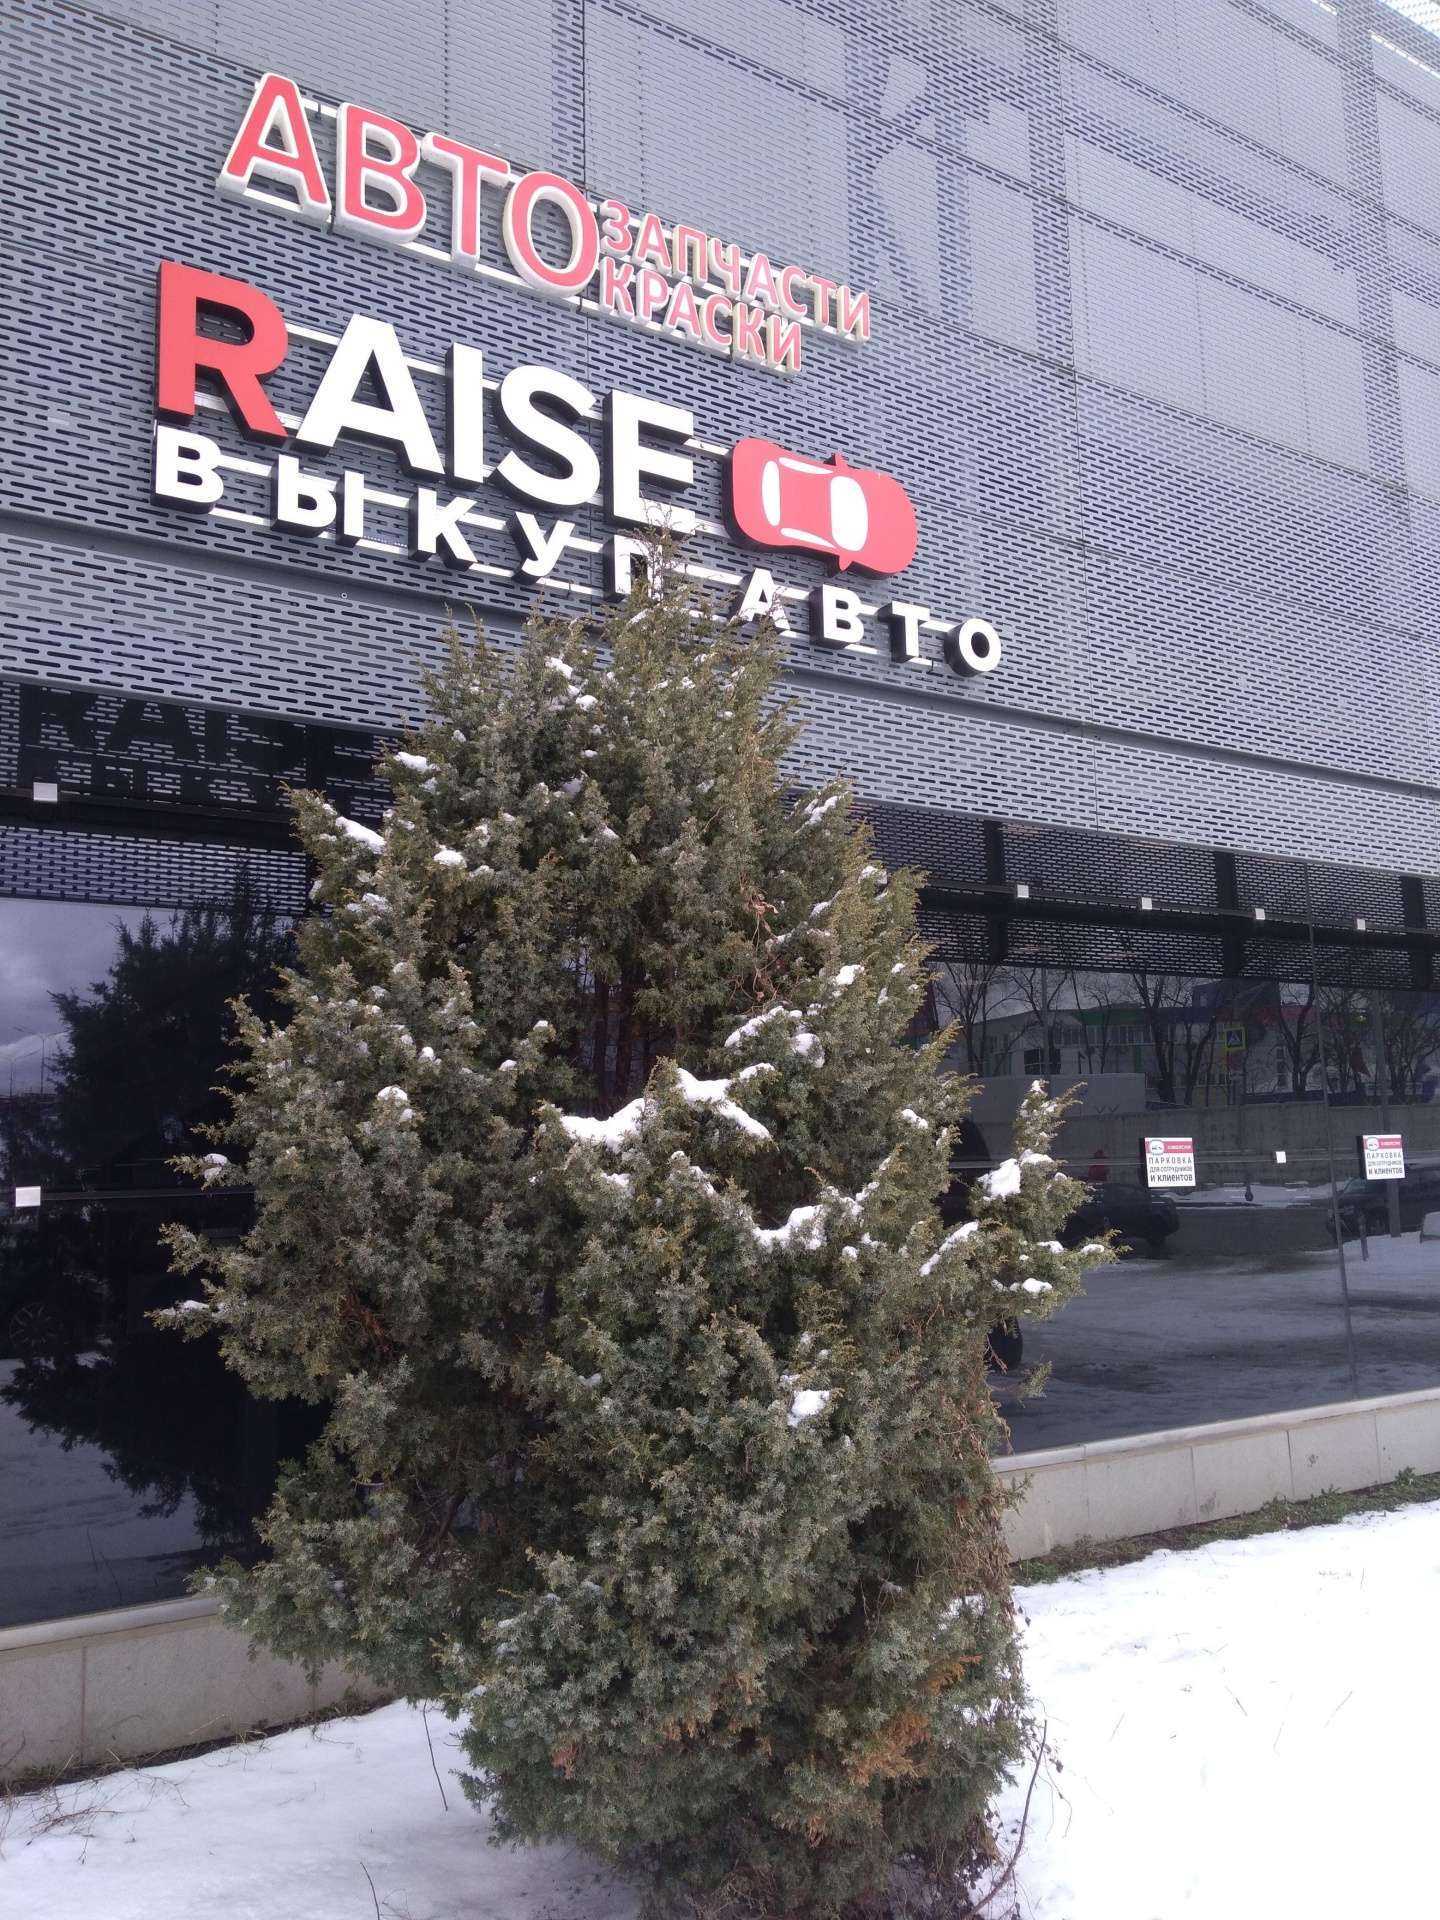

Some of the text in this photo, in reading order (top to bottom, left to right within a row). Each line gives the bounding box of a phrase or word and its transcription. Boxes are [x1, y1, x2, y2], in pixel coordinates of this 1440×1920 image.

[216, 71, 600, 299] АВТО
[600, 199, 872, 343] ЗАПЧАСТИ
[156, 260, 697, 538] RAISE
[599, 256, 802, 374] КРАСКИ
[153, 420, 1003, 677] ВЫКУП АВТО
[1148, 1156, 1193, 1165] ПАРКОВКА
